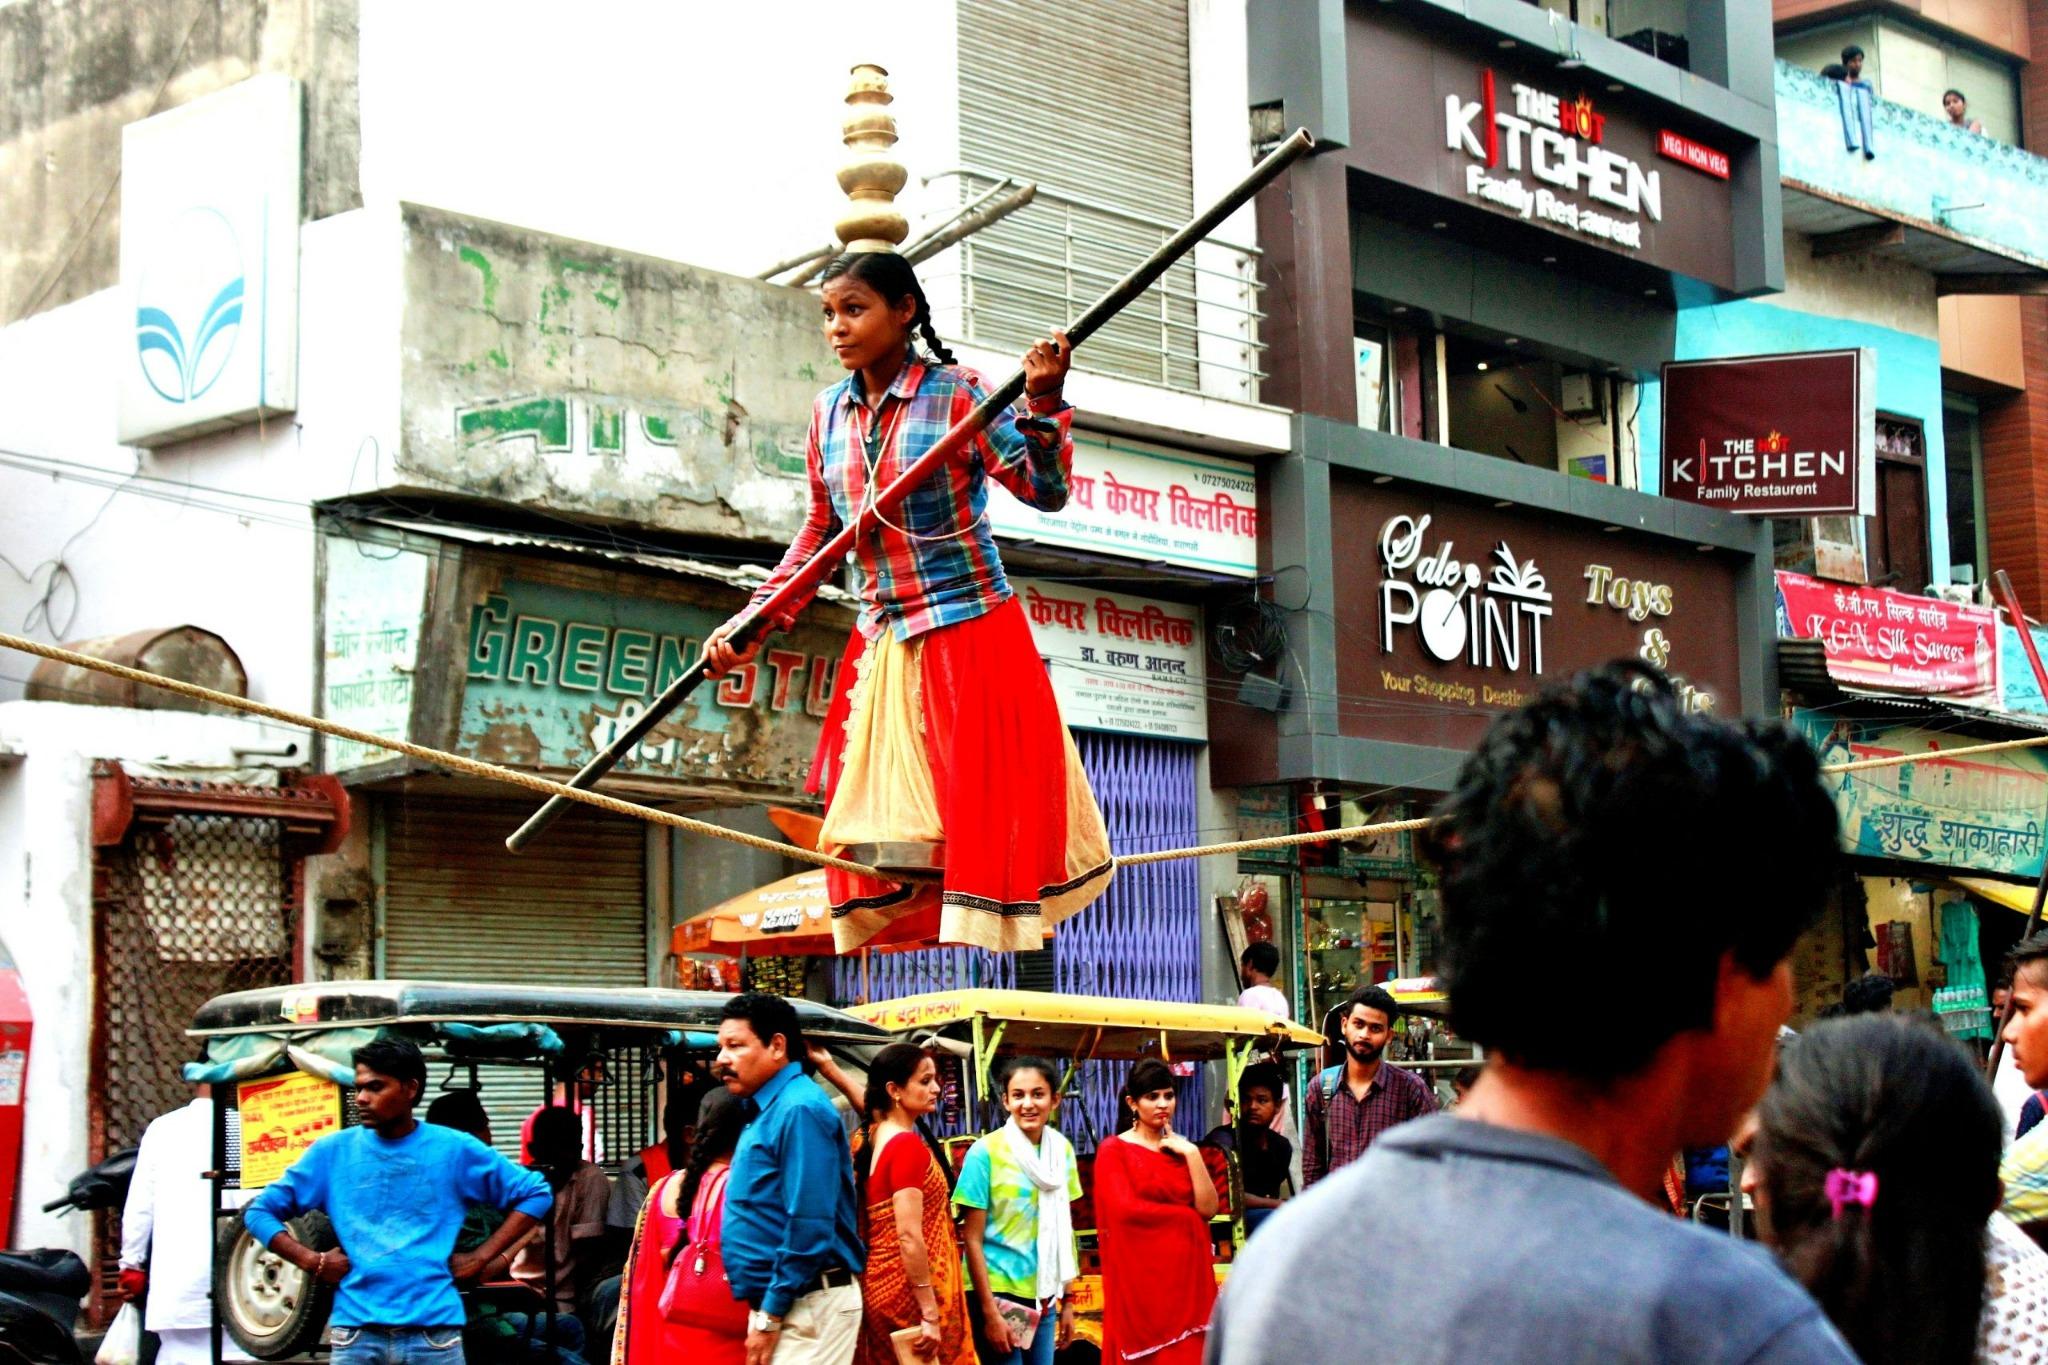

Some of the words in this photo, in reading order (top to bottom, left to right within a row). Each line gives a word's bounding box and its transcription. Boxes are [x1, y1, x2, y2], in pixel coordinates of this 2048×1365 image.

[1512, 82, 1560, 128] THE
[1559, 92, 1606, 144] HOT
[1446, 68, 1662, 222] KITCHEN
[1663, 133, 1682, 155] VEG
[1688, 144, 1707, 165] NON
[1708, 152, 1729, 174] VEG
[1466, 165, 1533, 219] Family
[1672, 438, 1845, 483] KITCHEN
[1724, 439, 1754, 455] THE
[1758, 431, 1790, 453] HOT
[1104, 471, 1160, 522] केयर
[1698, 484, 1740, 500] Family
[1744, 481, 1817, 498] Restaurent
[1378, 514, 1462, 586] Sale
[1584, 564, 1673, 621] Toys
[1886, 596, 1915, 625] सिल्क
[1027, 586, 1087, 632] केयर
[1094, 597, 1194, 647] क्लिनिक
[1379, 580, 1553, 675] POINT
[1105, 650, 1140, 669] वरुण
[1145, 655, 1187, 675] आनन्द
[1640, 628, 1671, 669] &
[1876, 626, 1910, 660] Silk
[1913, 633, 1966, 665] Sarees
[1380, 670, 1412, 693] Your
[1413, 674, 1476, 706] Shopping
[1880, 812, 1931, 852] शुद्ध
[1940, 820, 2041, 858] शाकाहारी
